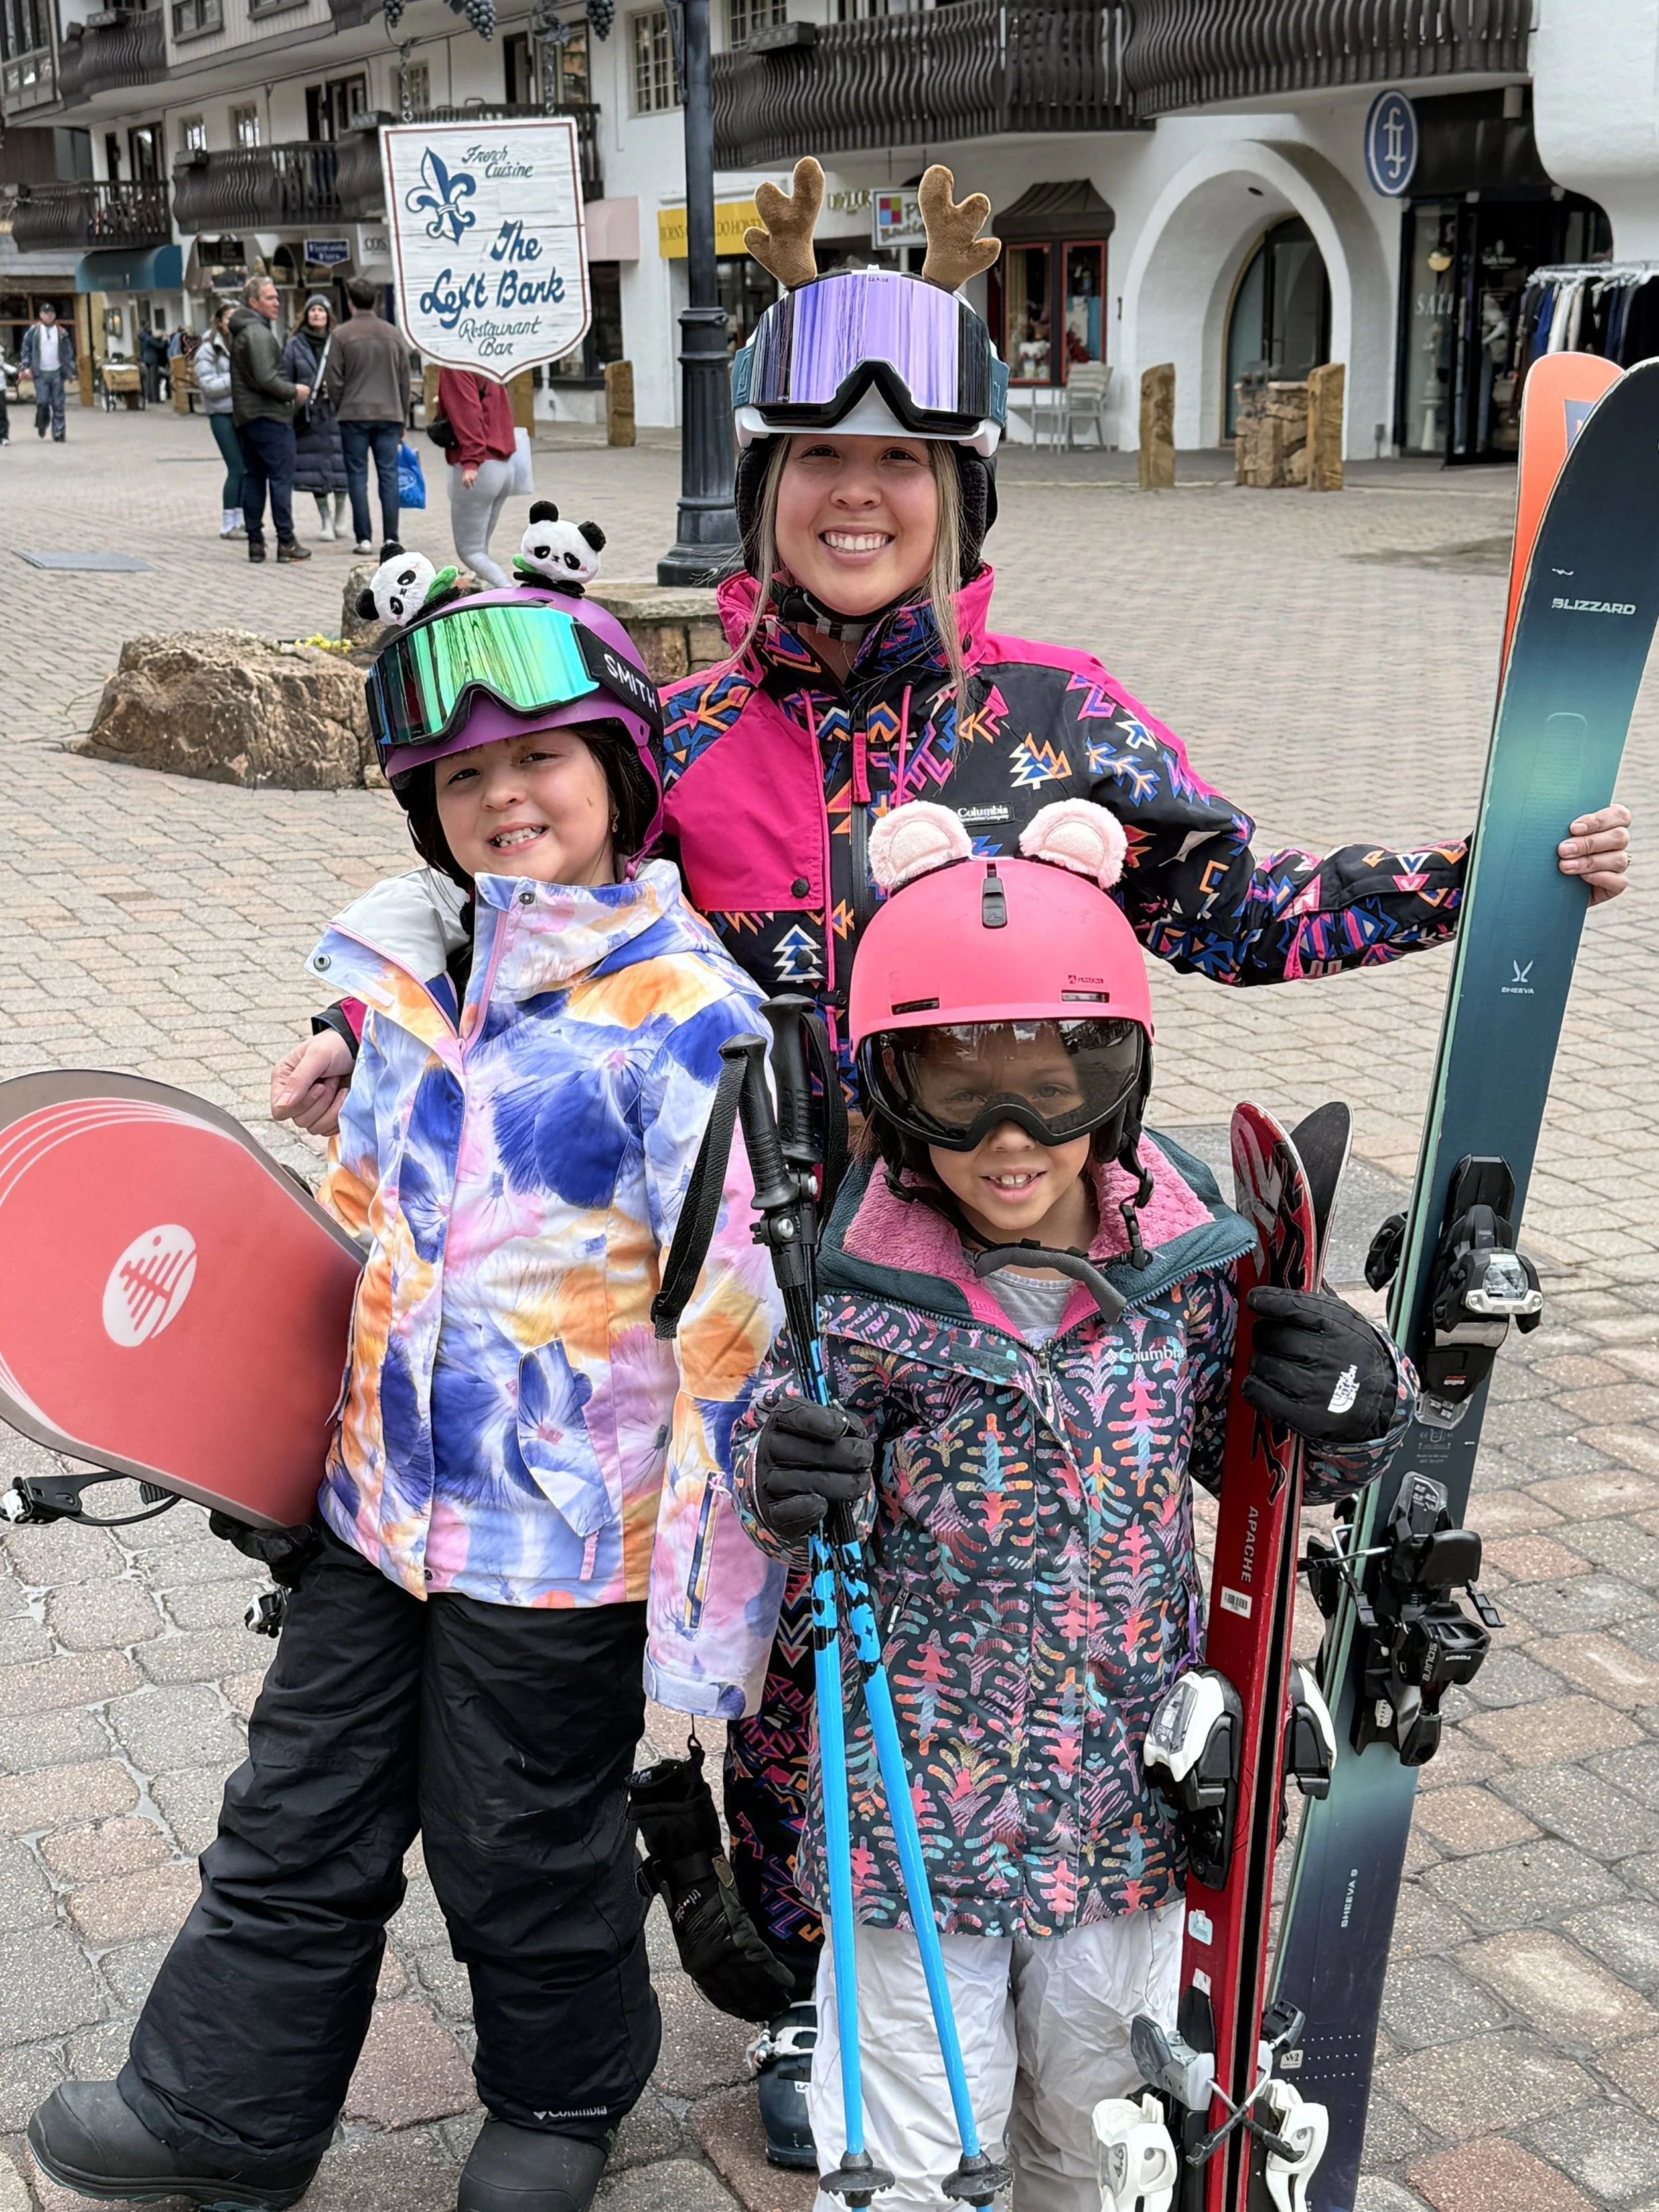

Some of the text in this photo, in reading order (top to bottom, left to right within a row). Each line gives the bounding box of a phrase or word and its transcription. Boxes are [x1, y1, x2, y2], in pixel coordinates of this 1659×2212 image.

[461, 145, 508, 163] French
[485, 161, 534, 178] Cuisine
[490, 220, 543, 261] The
[420, 267, 566, 329] Left Bank
[459, 316, 542, 342] Restaurant
[478, 338, 514, 356] Bar
[1551, 597, 1636, 615] BLIZZARD
[604, 653, 657, 713] SMITH
[958, 805, 1008, 817] Columbia
[1119, 1345, 1185, 1363] Columbia
[1241, 1505, 1258, 1583] APACHE
[1340, 1880, 1356, 1927] SHEEVA
